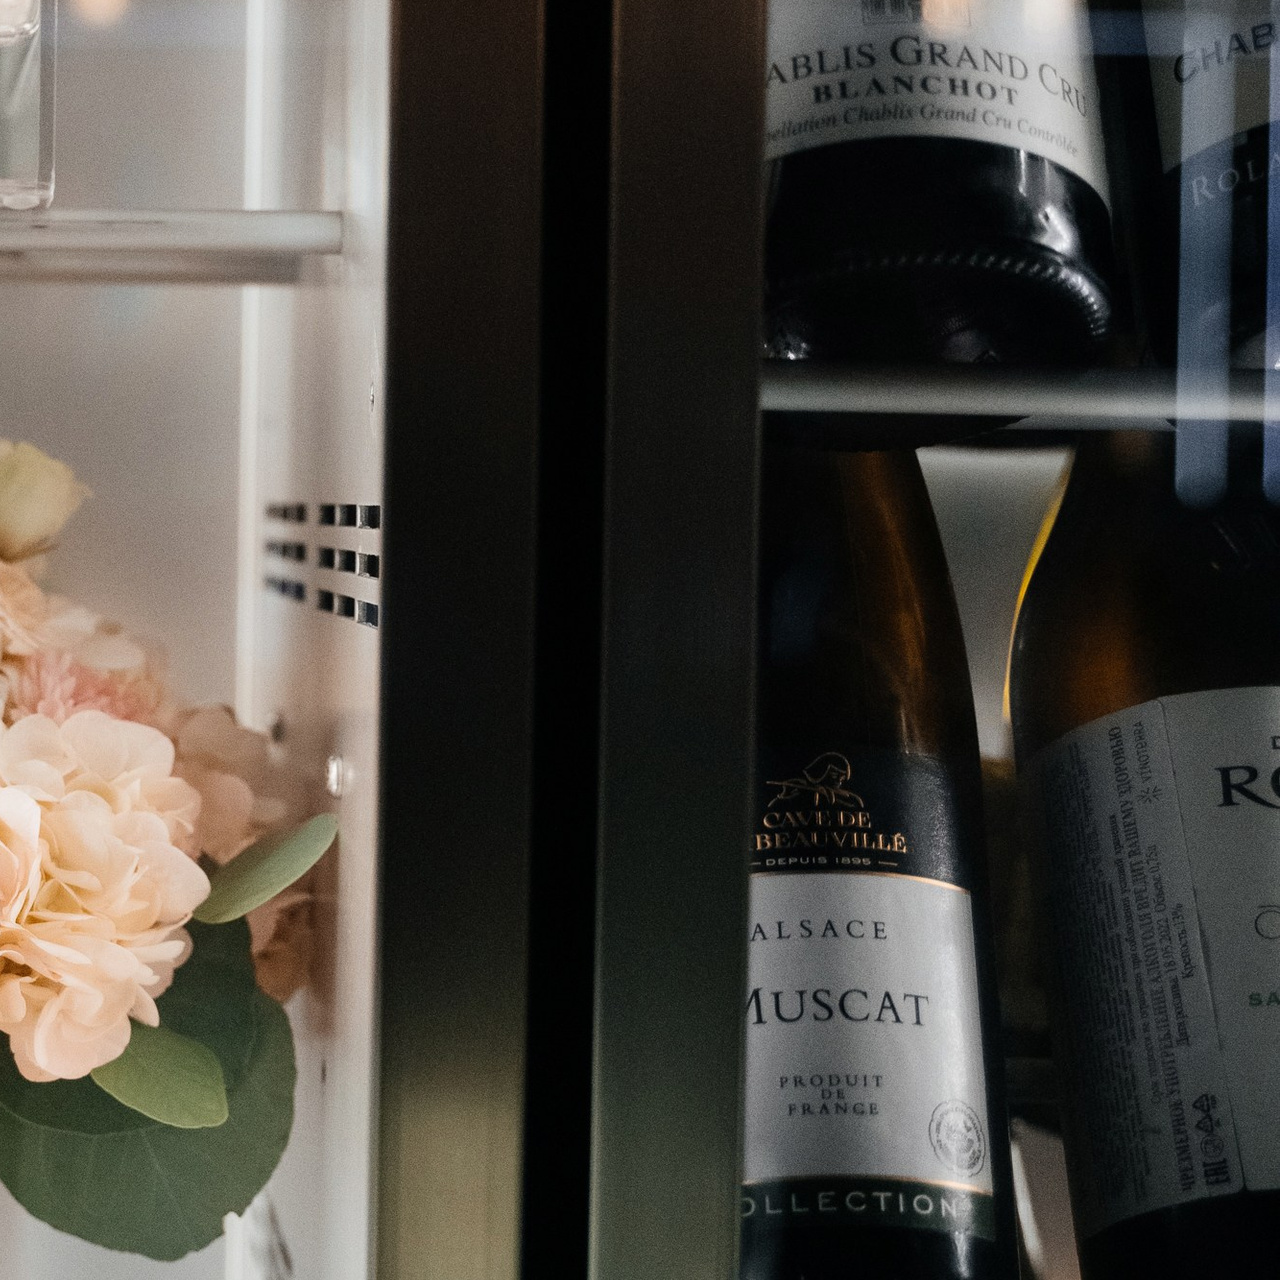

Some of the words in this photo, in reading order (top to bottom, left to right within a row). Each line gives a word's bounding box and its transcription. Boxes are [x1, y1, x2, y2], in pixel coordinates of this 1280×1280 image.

[813, 74, 1019, 106] BLANCHOT
[844, 103, 914, 125] Chablis
[920, 103, 977, 123] Grand
[982, 111, 1013, 131] Cru
[1017, 119, 1079, 158] Contrôlée
[1213, 764, 1280, 811] R
[763, 811, 830, 829] CAVE
[839, 811, 872, 829] DE
[766, 857, 828, 867] DEPUIS
[835, 857, 871, 866] 1895
[750, 919, 888, 941] ALSACE
[746, 986, 929, 1026] MUSCAT
[779, 1074, 883, 1089] PRODUIT
[821, 1089, 846, 1100] DE
[787, 1101, 880, 1117] FRANCE
